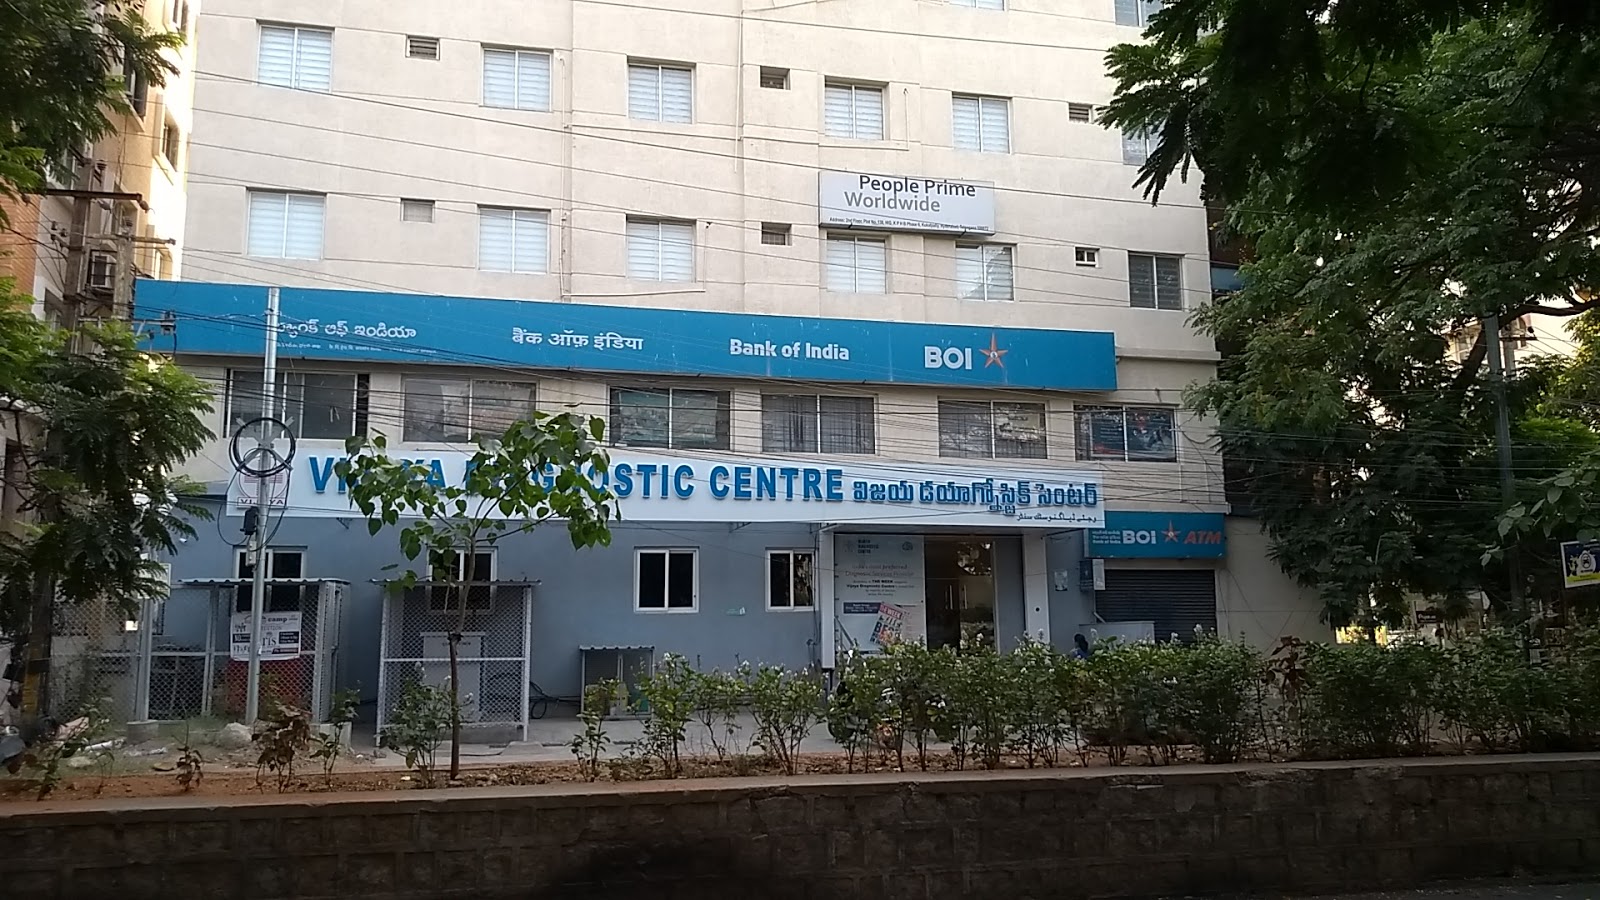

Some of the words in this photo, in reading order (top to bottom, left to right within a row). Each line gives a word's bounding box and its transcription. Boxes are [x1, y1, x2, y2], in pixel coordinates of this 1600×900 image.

[859, 174, 920, 195] People
[925, 179, 976, 197] Prime
[844, 191, 941, 212] Worldwide
[354, 322, 417, 339] ఇండియా
[512, 327, 543, 345] बैंक
[594, 332, 644, 351] इंडिया
[730, 338, 777, 357] Bank
[781, 341, 801, 358] of
[805, 342, 850, 360] India
[924, 346, 973, 370] BOI
[709, 465, 844, 502] CENTRE
[853, 479, 914, 503] విజయ
[1037, 482, 1098, 507] సెంటర్
[1122, 530, 1157, 545] BOI
[1184, 530, 1222, 545] ATM
